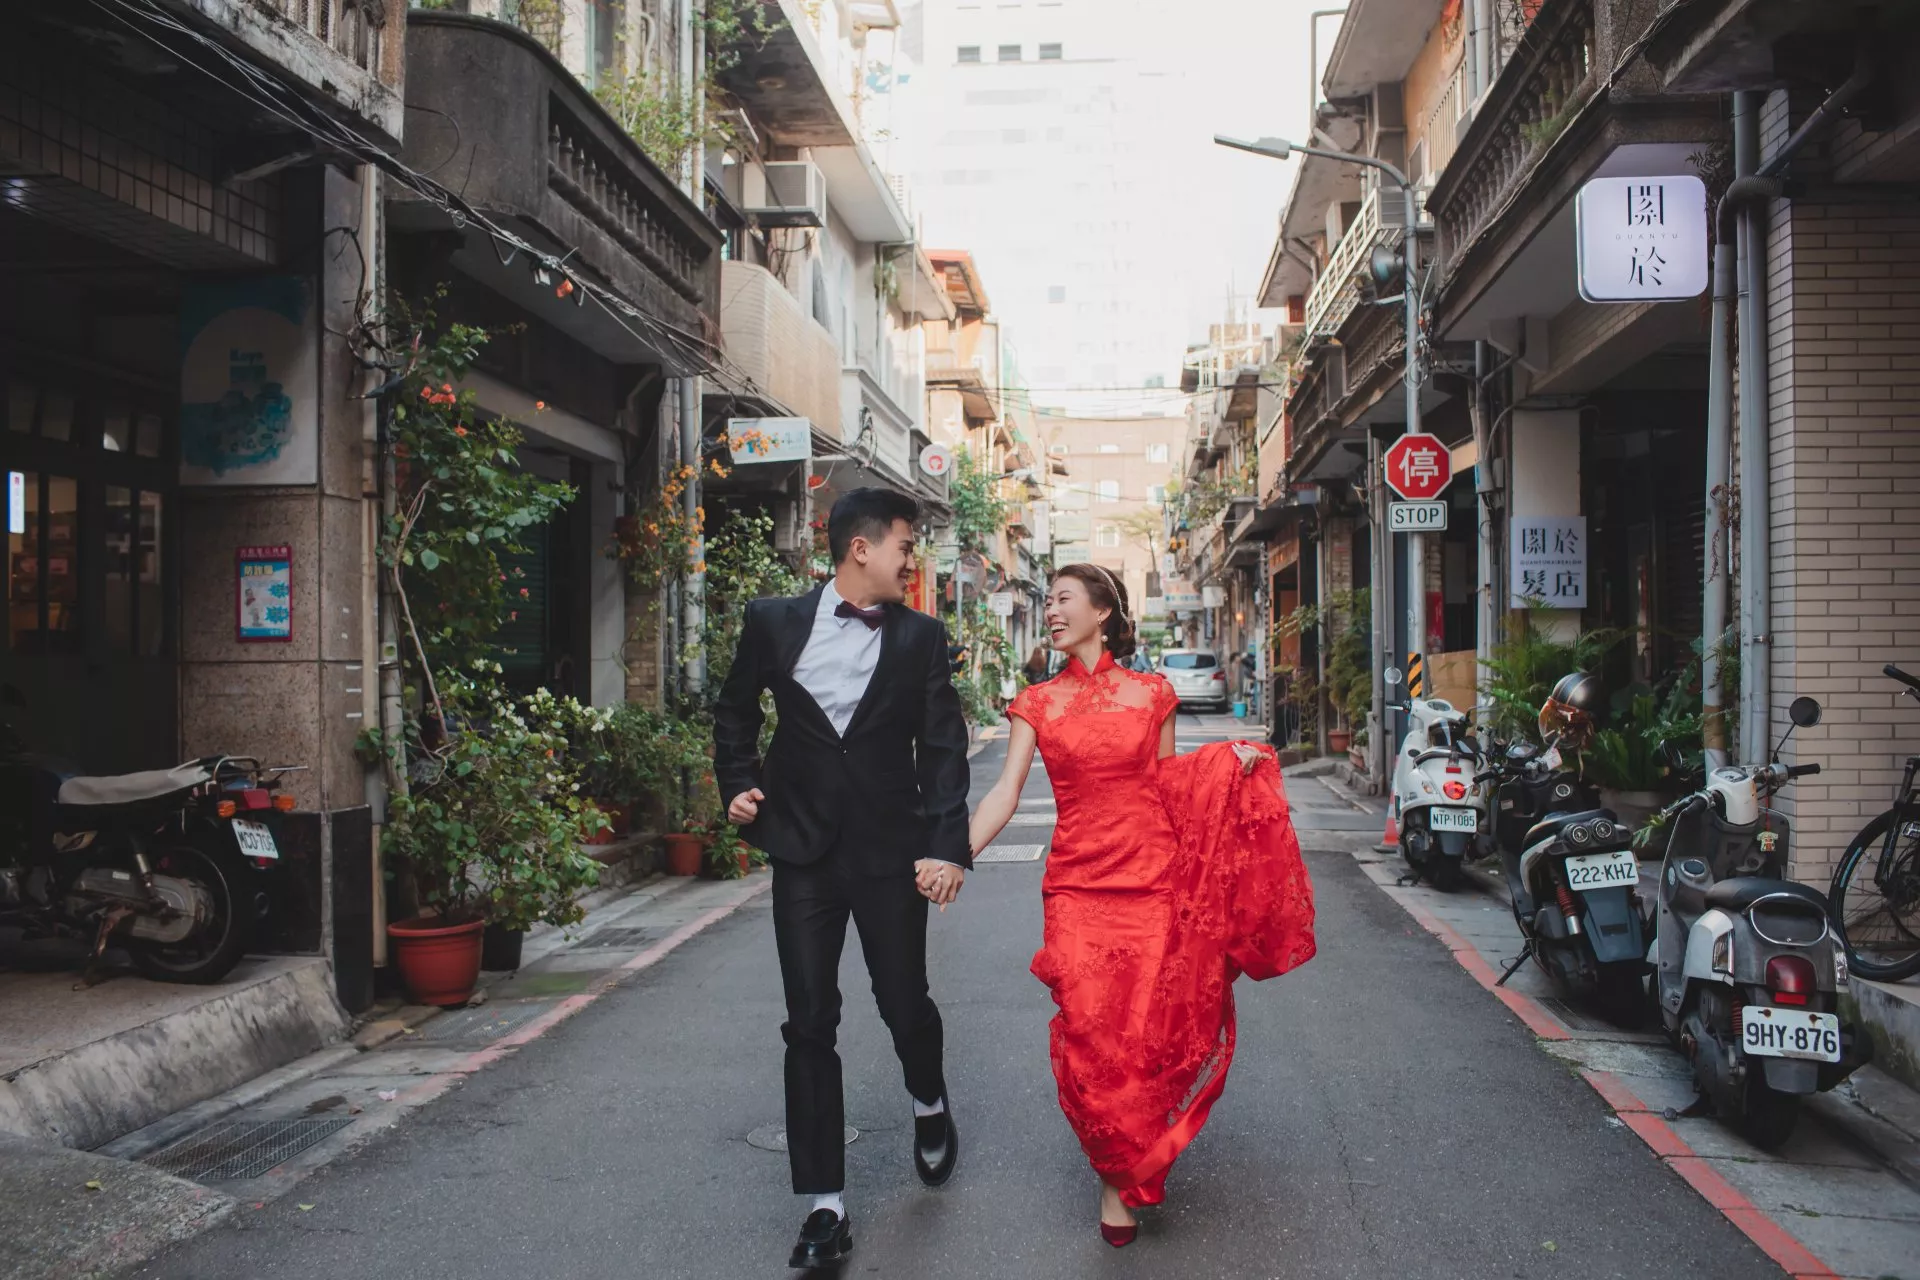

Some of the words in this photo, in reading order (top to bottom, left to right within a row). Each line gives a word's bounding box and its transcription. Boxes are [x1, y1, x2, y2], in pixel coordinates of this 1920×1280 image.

[1398, 447, 1439, 488] 停
[1395, 508, 1439, 523] STOP
[1522, 528, 1579, 554] 關於
[1522, 570, 1581, 597] 髮店
[1746, 1022, 1837, 1054] 9HY-876
